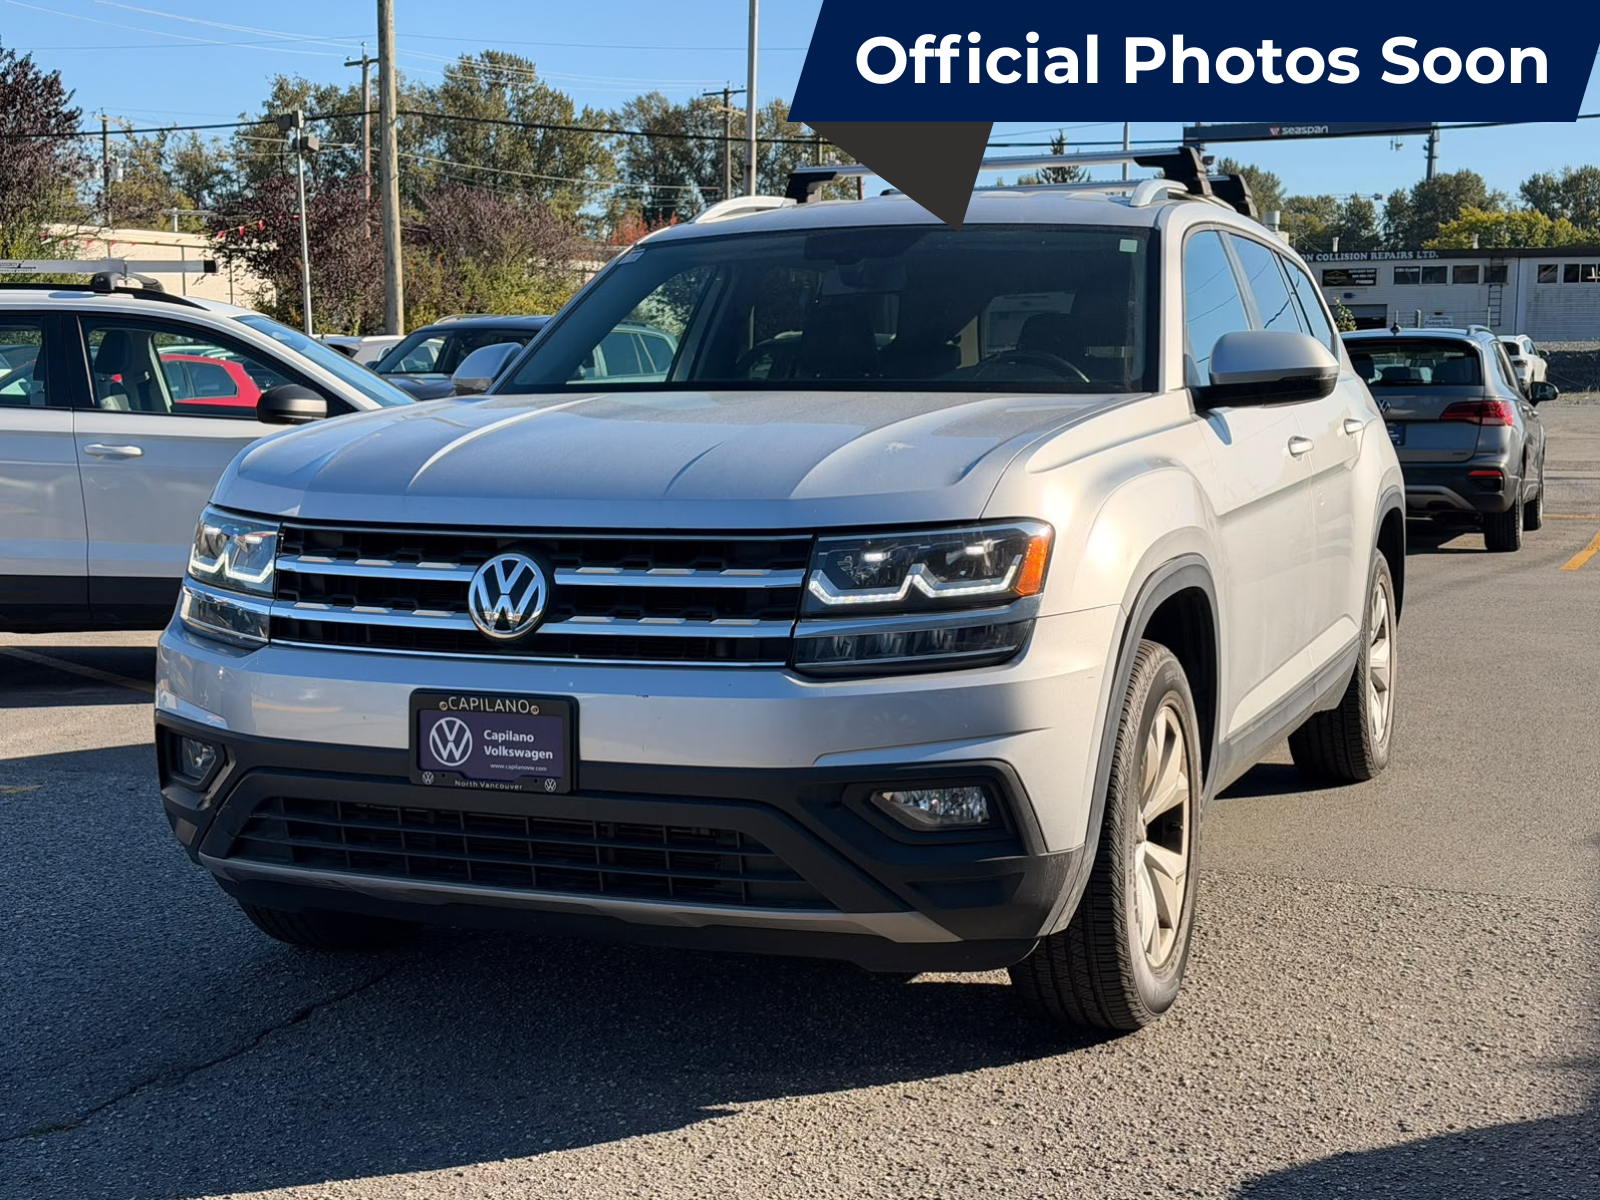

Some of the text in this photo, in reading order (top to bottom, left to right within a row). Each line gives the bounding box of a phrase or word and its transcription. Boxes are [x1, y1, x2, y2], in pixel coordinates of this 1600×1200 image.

[1281, 125, 1329, 136] seaspan
[1316, 252, 1368, 261] COLLISION
[1370, 251, 1414, 260] REPAIRS
[1416, 250, 1439, 259] LTD.
[448, 696, 530, 714] CAPILANO
[483, 729, 535, 743] Capilano
[483, 745, 553, 761] Volkswagen
[454, 779, 523, 790] North Vancouver
